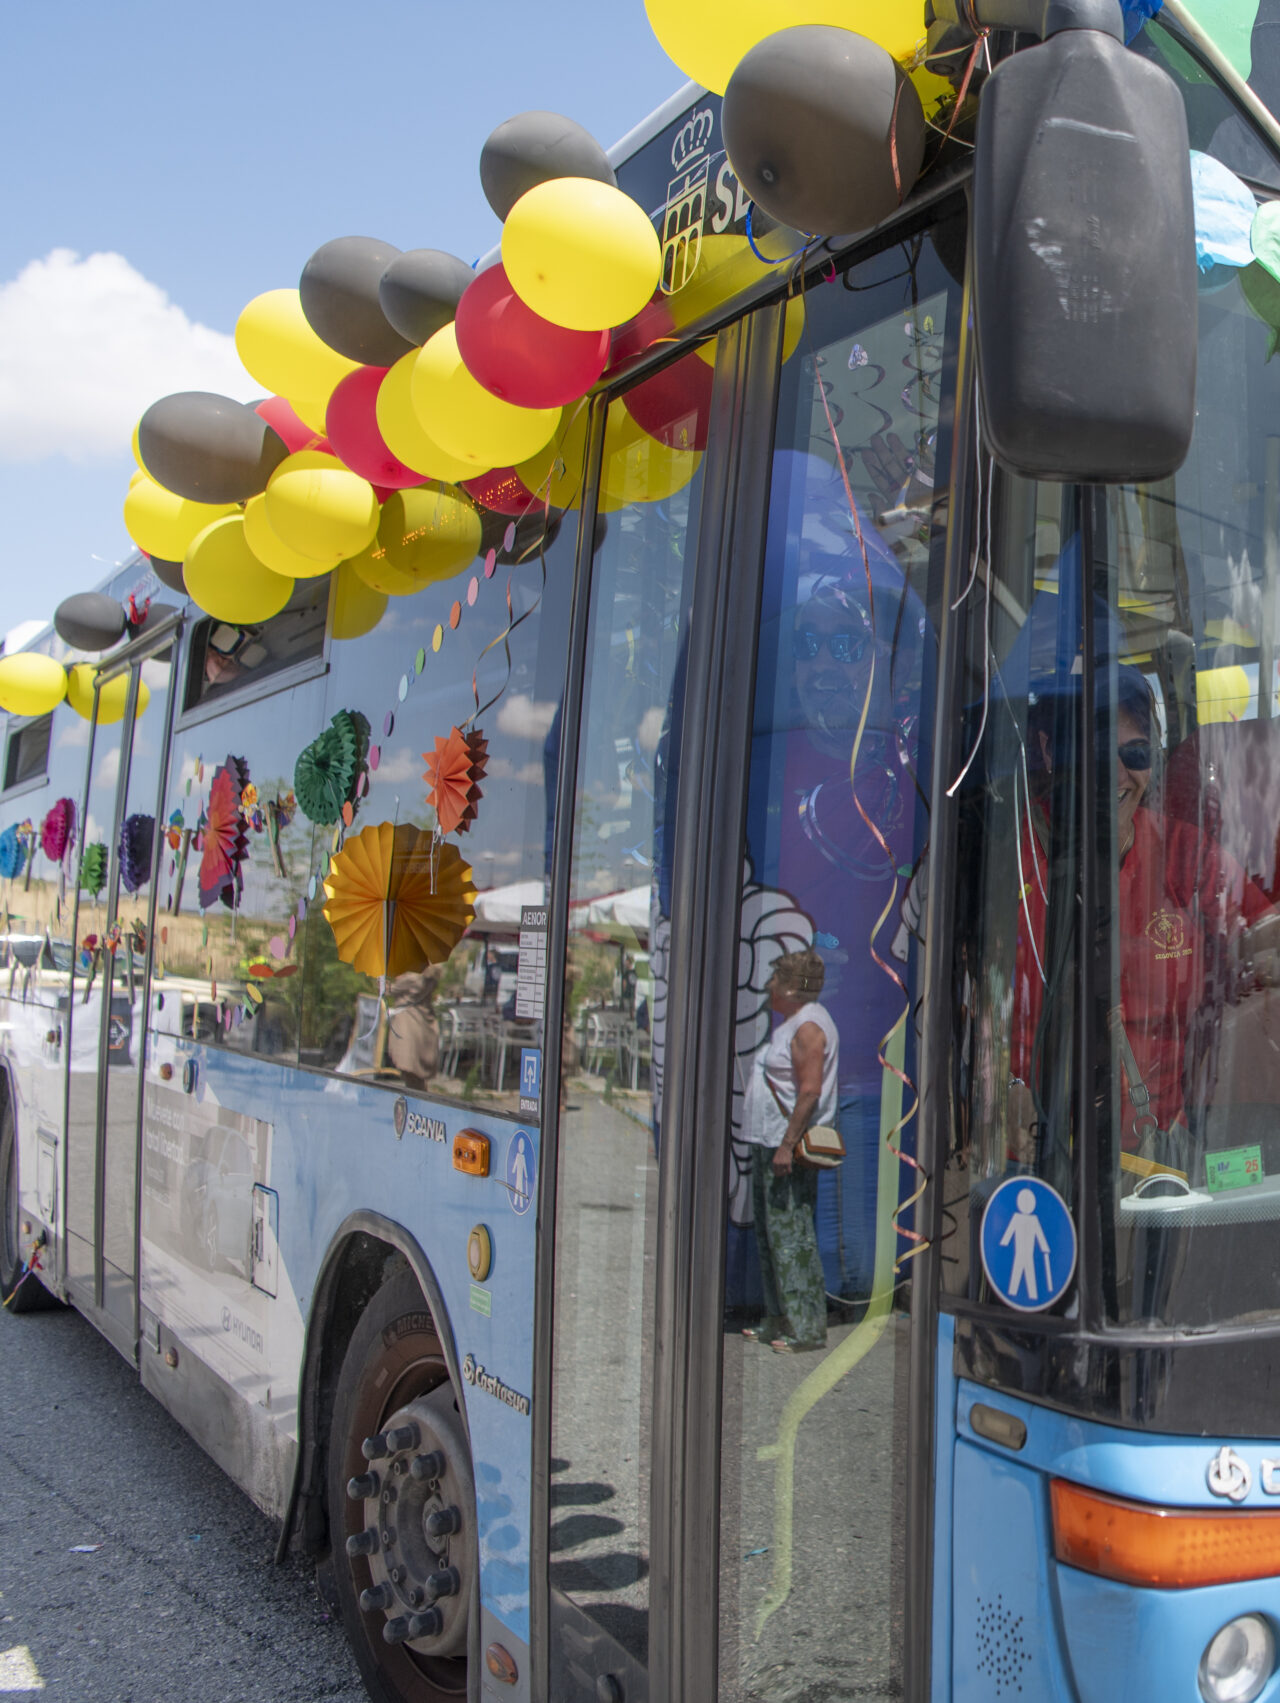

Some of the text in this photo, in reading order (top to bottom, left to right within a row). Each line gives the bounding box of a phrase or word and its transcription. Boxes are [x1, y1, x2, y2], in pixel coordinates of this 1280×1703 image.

[522, 911, 547, 926] AENOR
[520, 1099, 538, 1112] ENTRADA
[407, 1112, 447, 1144] SCANIA
[232, 1315, 264, 1354] HYUNDAI
[475, 1364, 531, 1416] Castrosua
